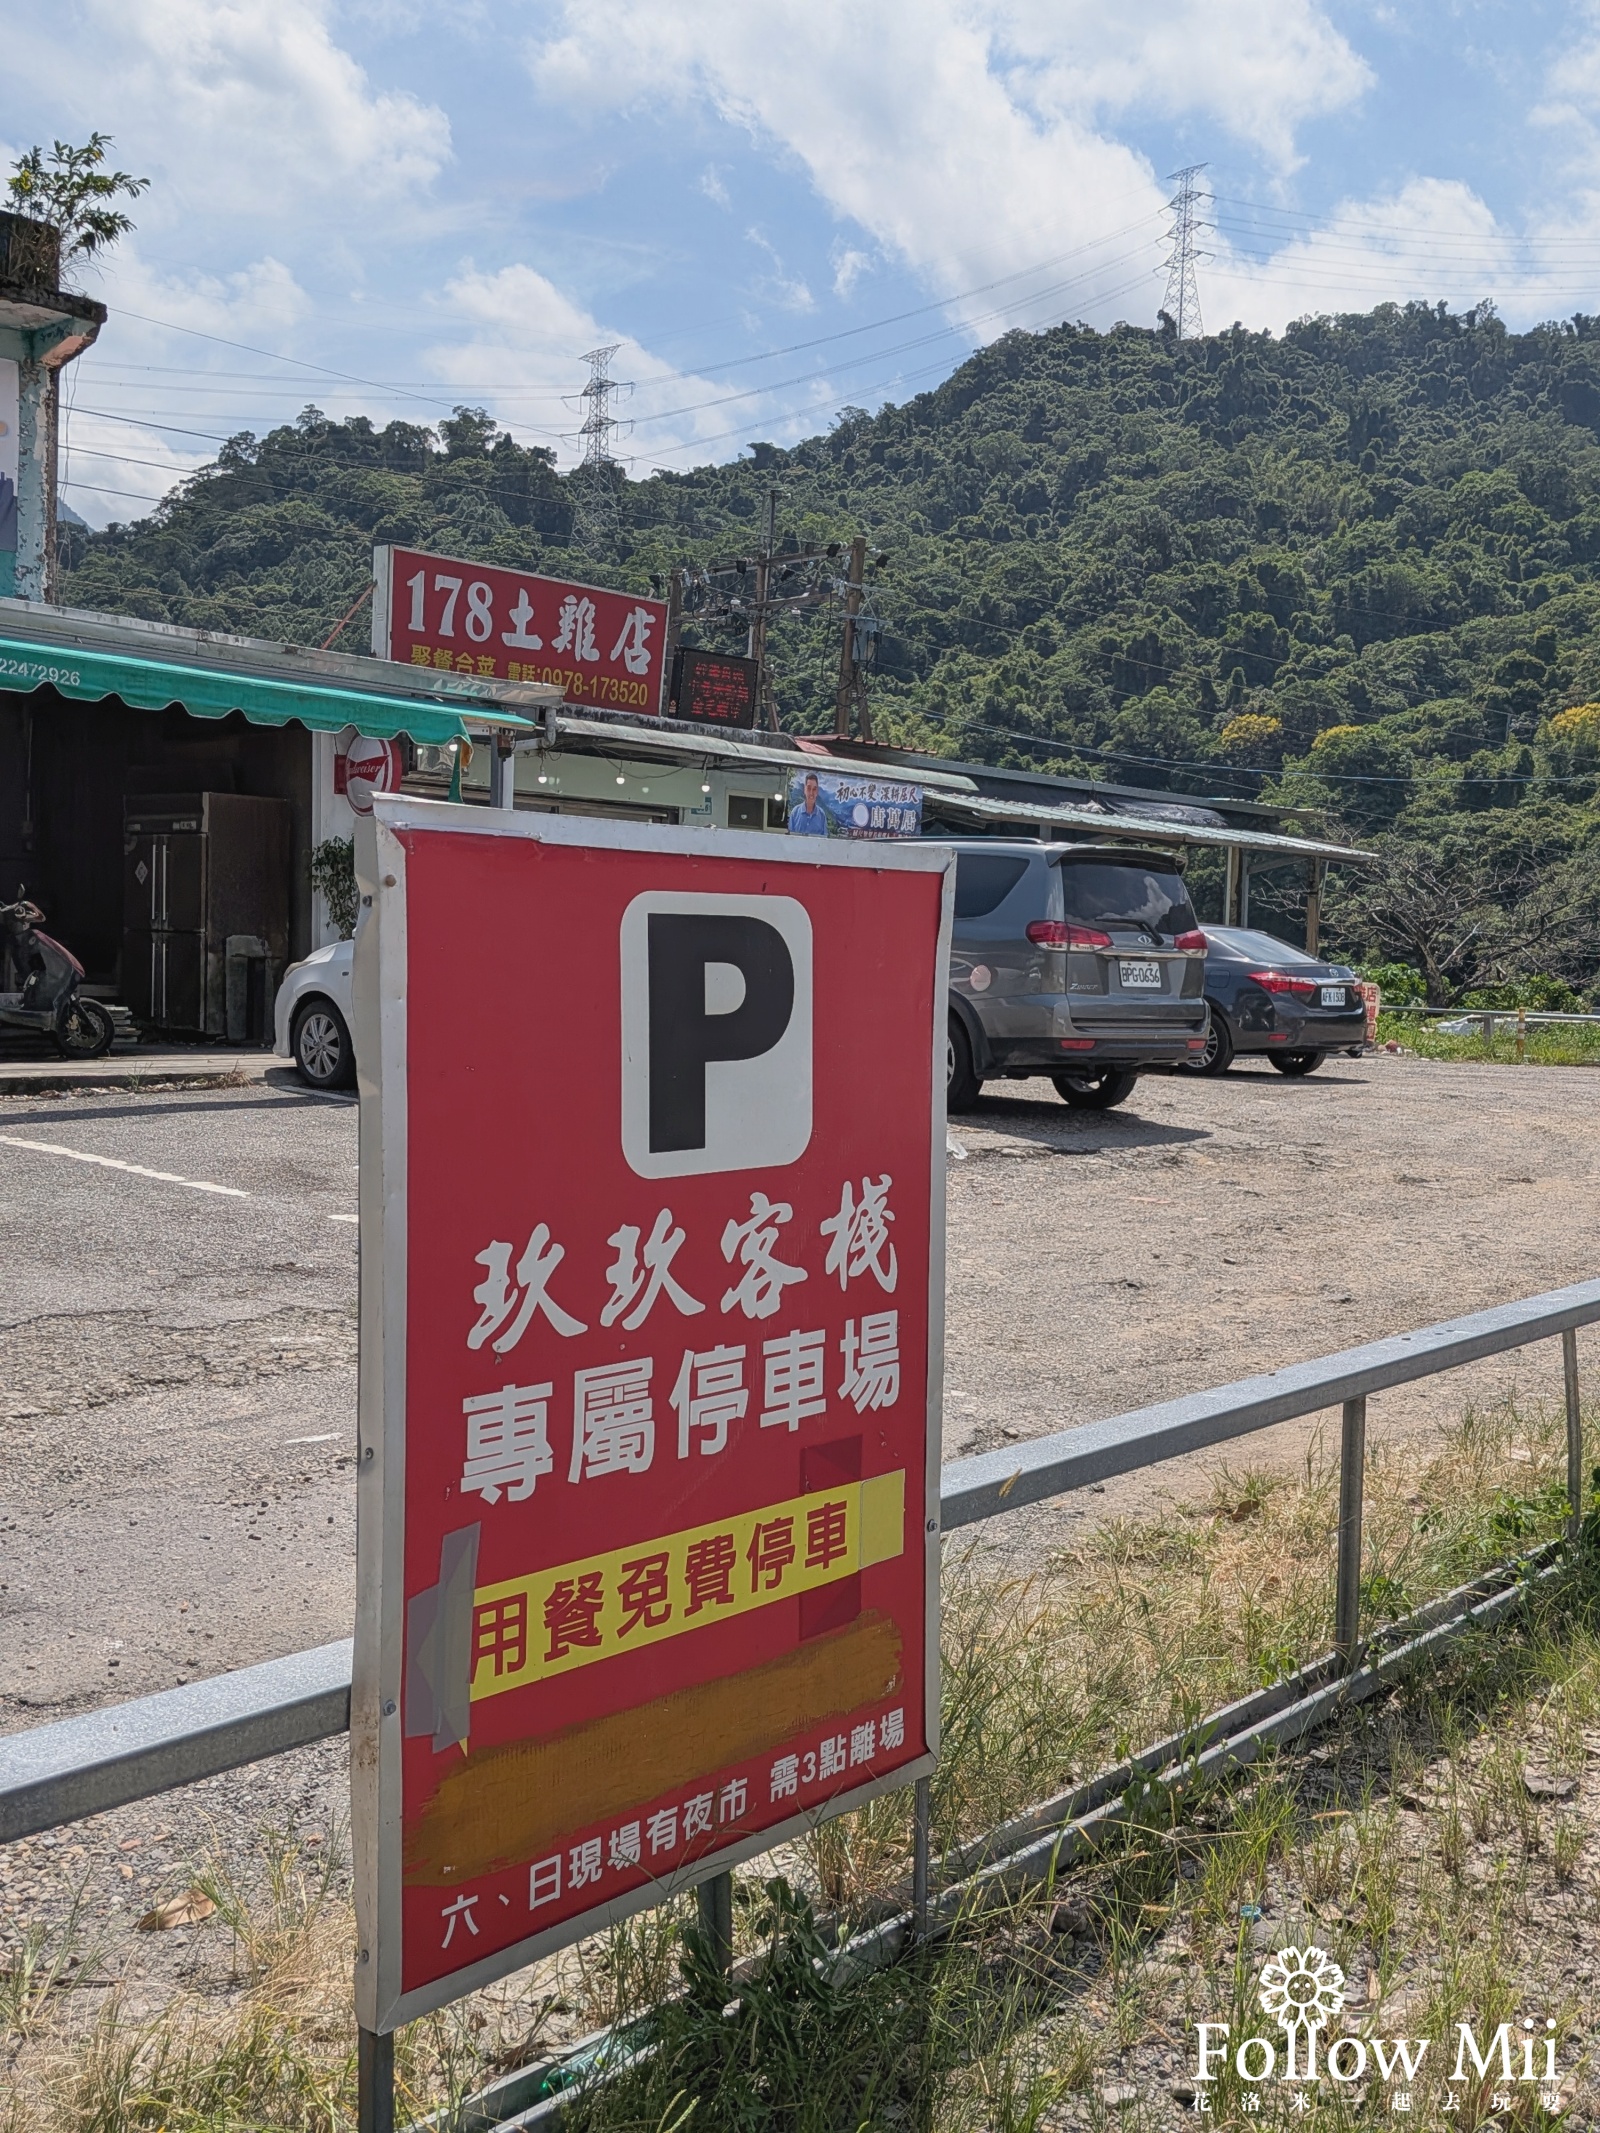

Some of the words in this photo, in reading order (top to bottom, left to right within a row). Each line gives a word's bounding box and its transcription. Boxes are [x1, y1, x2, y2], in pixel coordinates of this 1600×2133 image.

[407, 570, 656, 675] 178土雞店
[411, 644, 497, 677] 聚餐合菜
[648, 913, 794, 1153] P
[467, 1174, 898, 1353] 玖玖客棧
[460, 1310, 899, 1505] 專屬停車場
[467, 1500, 848, 1684] 用餐免費停車
[770, 1708, 904, 1803] 需3點離場
